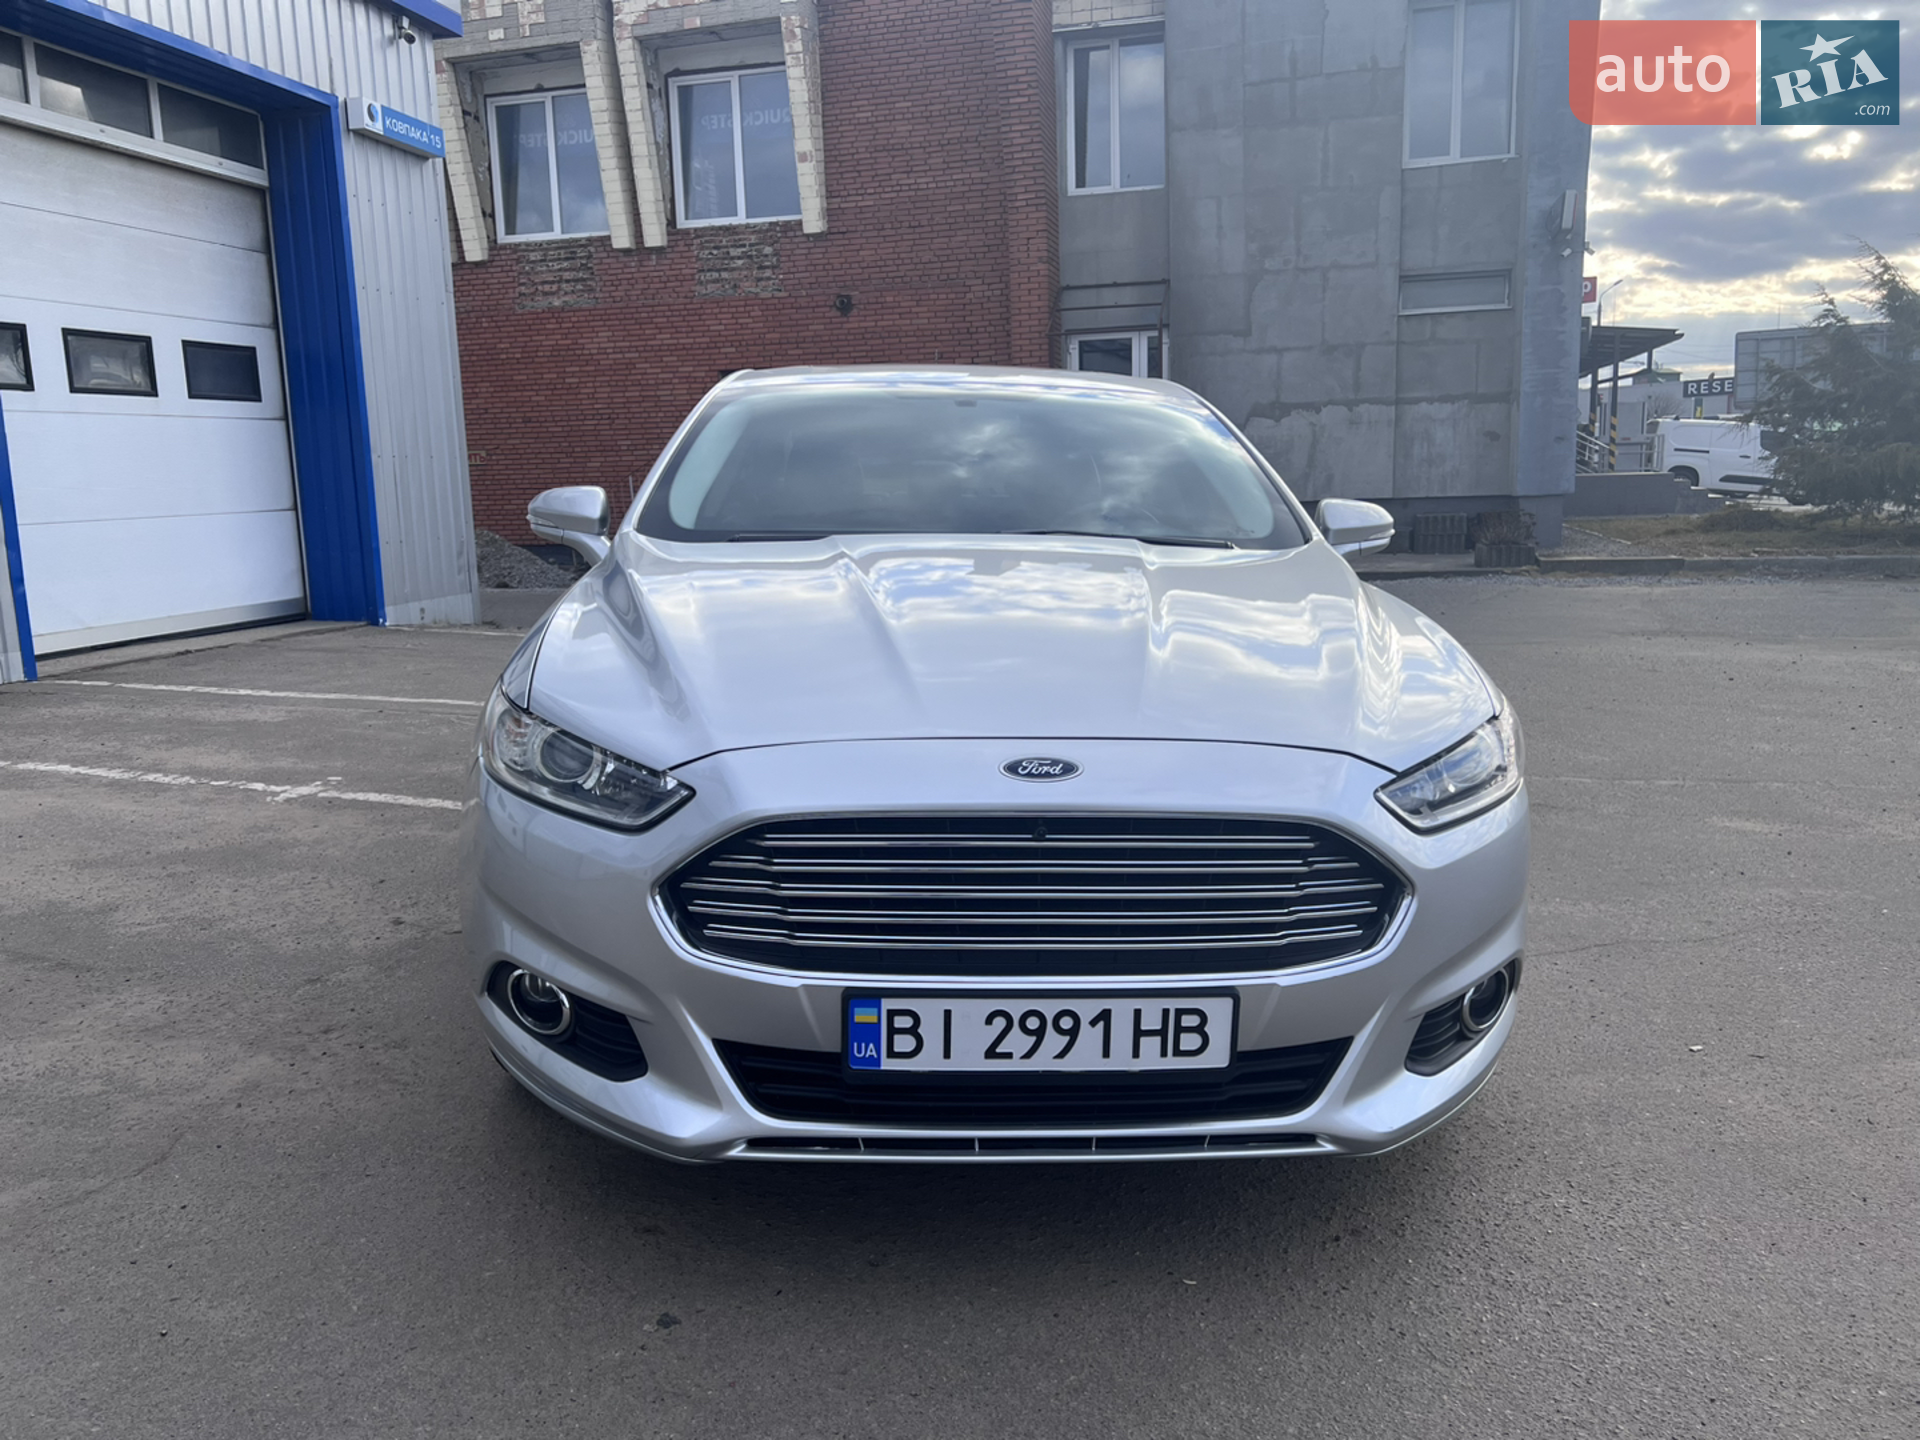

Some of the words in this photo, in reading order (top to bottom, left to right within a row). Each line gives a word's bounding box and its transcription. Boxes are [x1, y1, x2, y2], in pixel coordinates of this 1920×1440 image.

[385, 115, 429, 145] КОВПАКА
[430, 133, 442, 150] 15
[1018, 759, 1064, 775] Ford
[983, 1008, 1113, 1060] 2991
[1131, 1007, 1211, 1059] HB
[853, 1042, 878, 1059] UA
